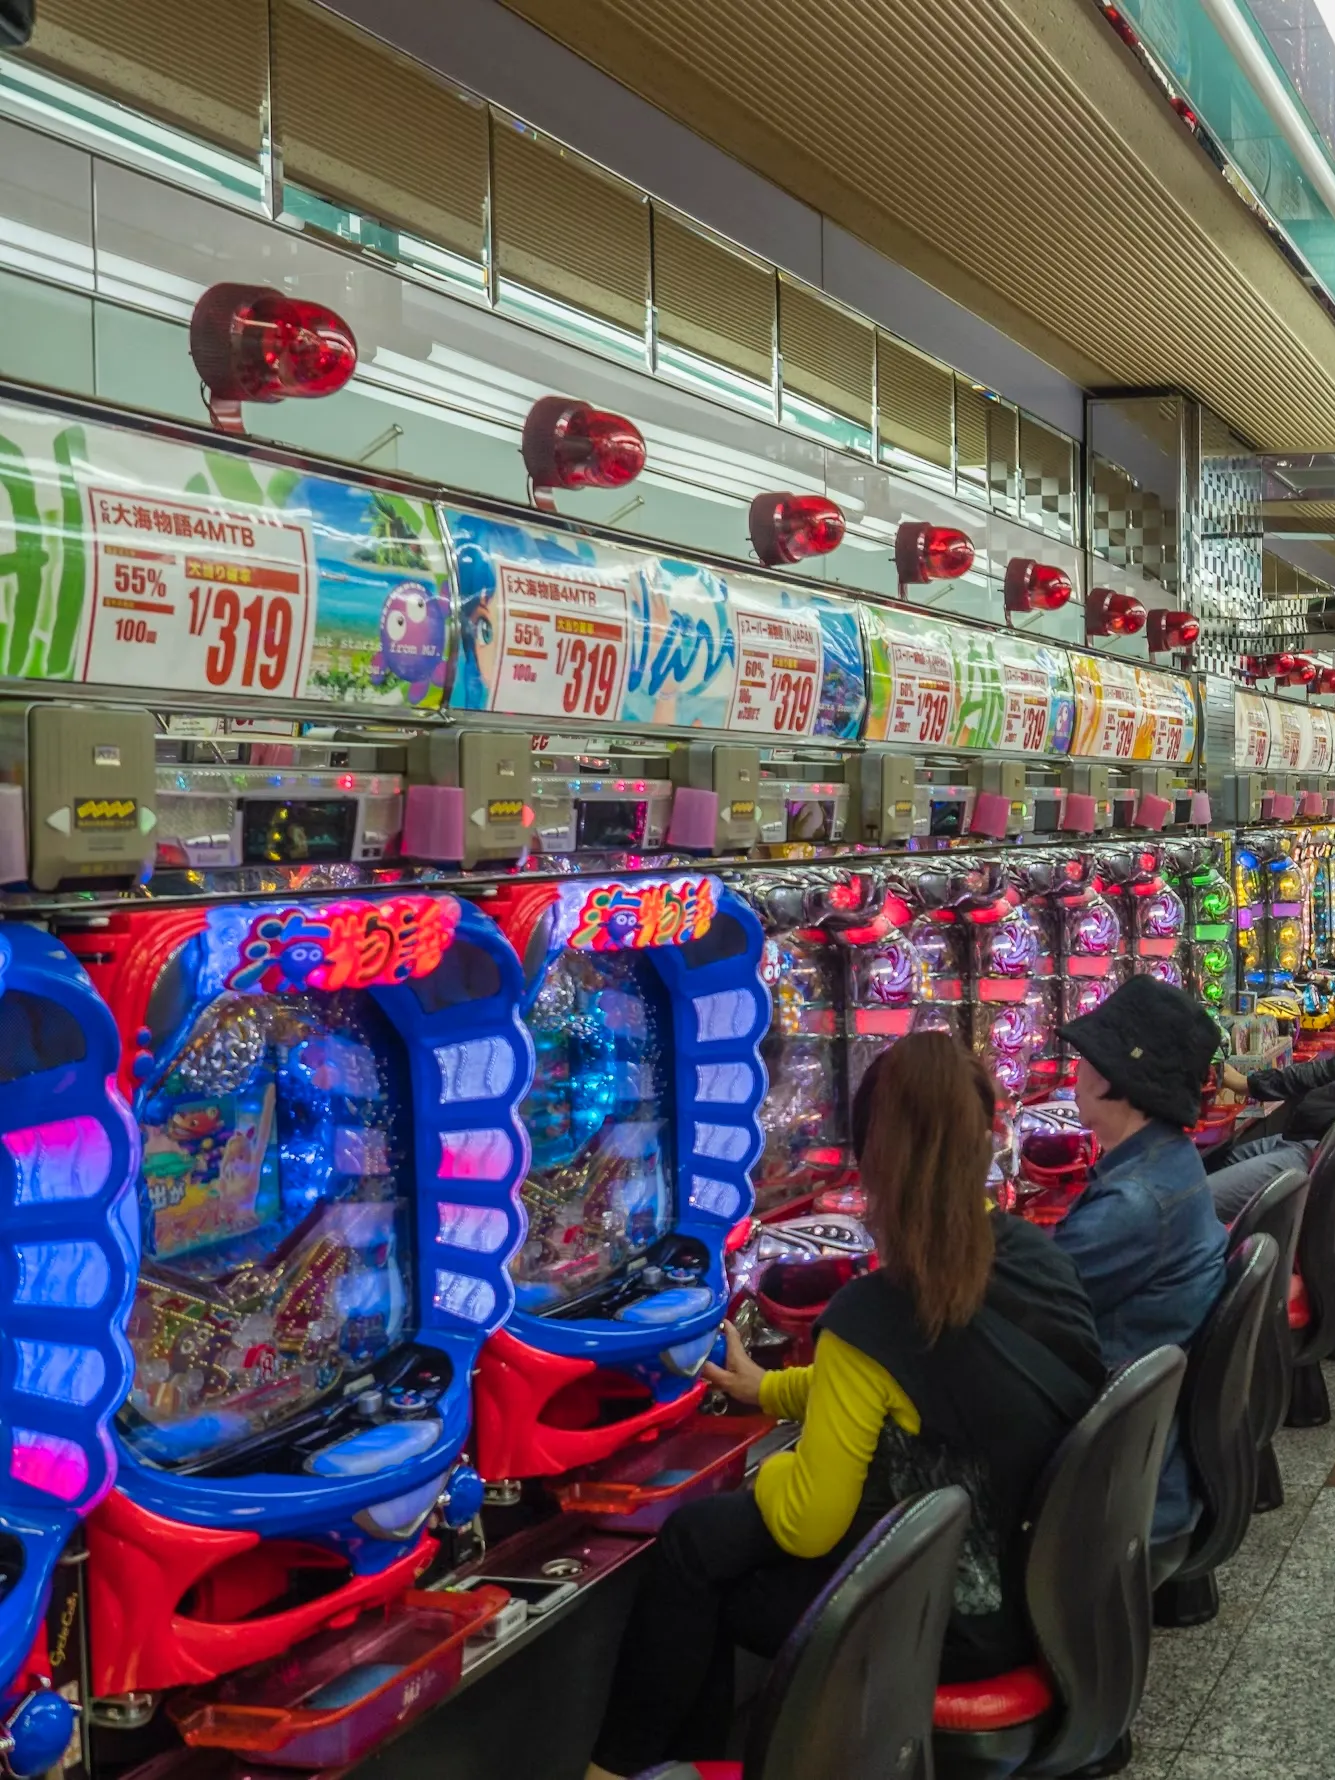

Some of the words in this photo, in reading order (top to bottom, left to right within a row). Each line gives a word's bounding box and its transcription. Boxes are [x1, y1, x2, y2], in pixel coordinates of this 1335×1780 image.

[114, 562, 167, 597] 55%
[188, 586, 293, 691] 1/319
[389, 641, 418, 655] from
[513, 622, 545, 648] 55%
[555, 637, 618, 716] 1/319
[744, 660, 765, 679] 60%
[769, 672, 814, 733] 1/319
[916, 692, 949, 743] 1/319
